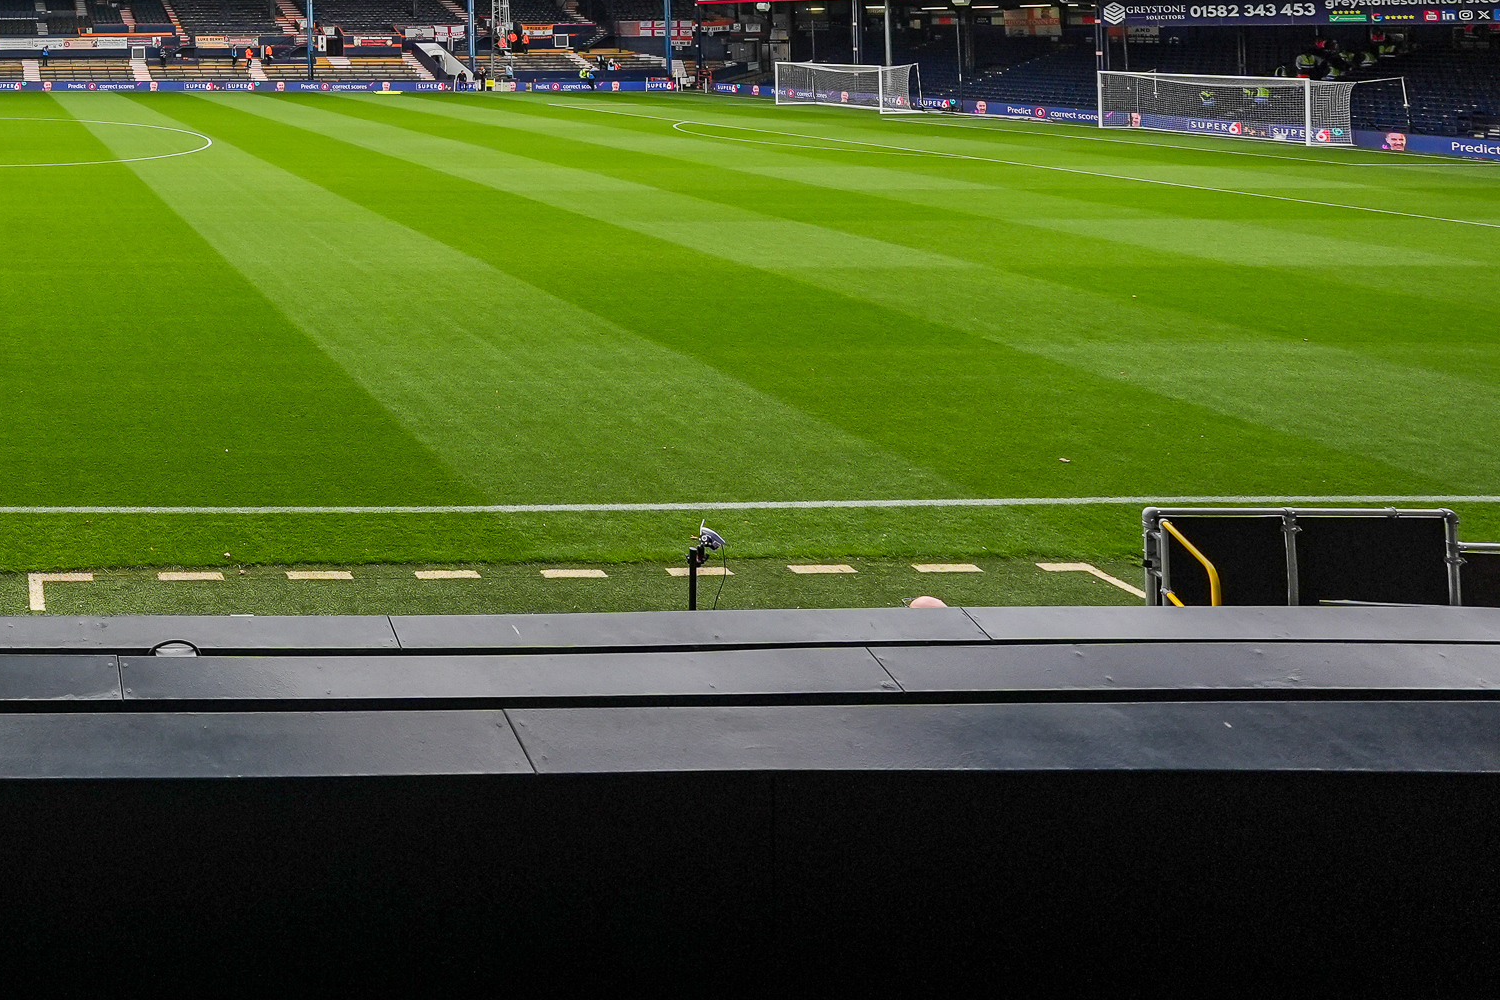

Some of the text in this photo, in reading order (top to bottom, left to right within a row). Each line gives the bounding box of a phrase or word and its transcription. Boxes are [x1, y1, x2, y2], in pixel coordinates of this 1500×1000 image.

[1125, 3, 1187, 15] GREYSTONE
[1190, 2, 1316, 18] 01582 343 453
[1007, 106, 1099, 121] Predict correct score
[1190, 120, 1241, 135] SUPER6
[1451, 141, 1500, 155] Predict
